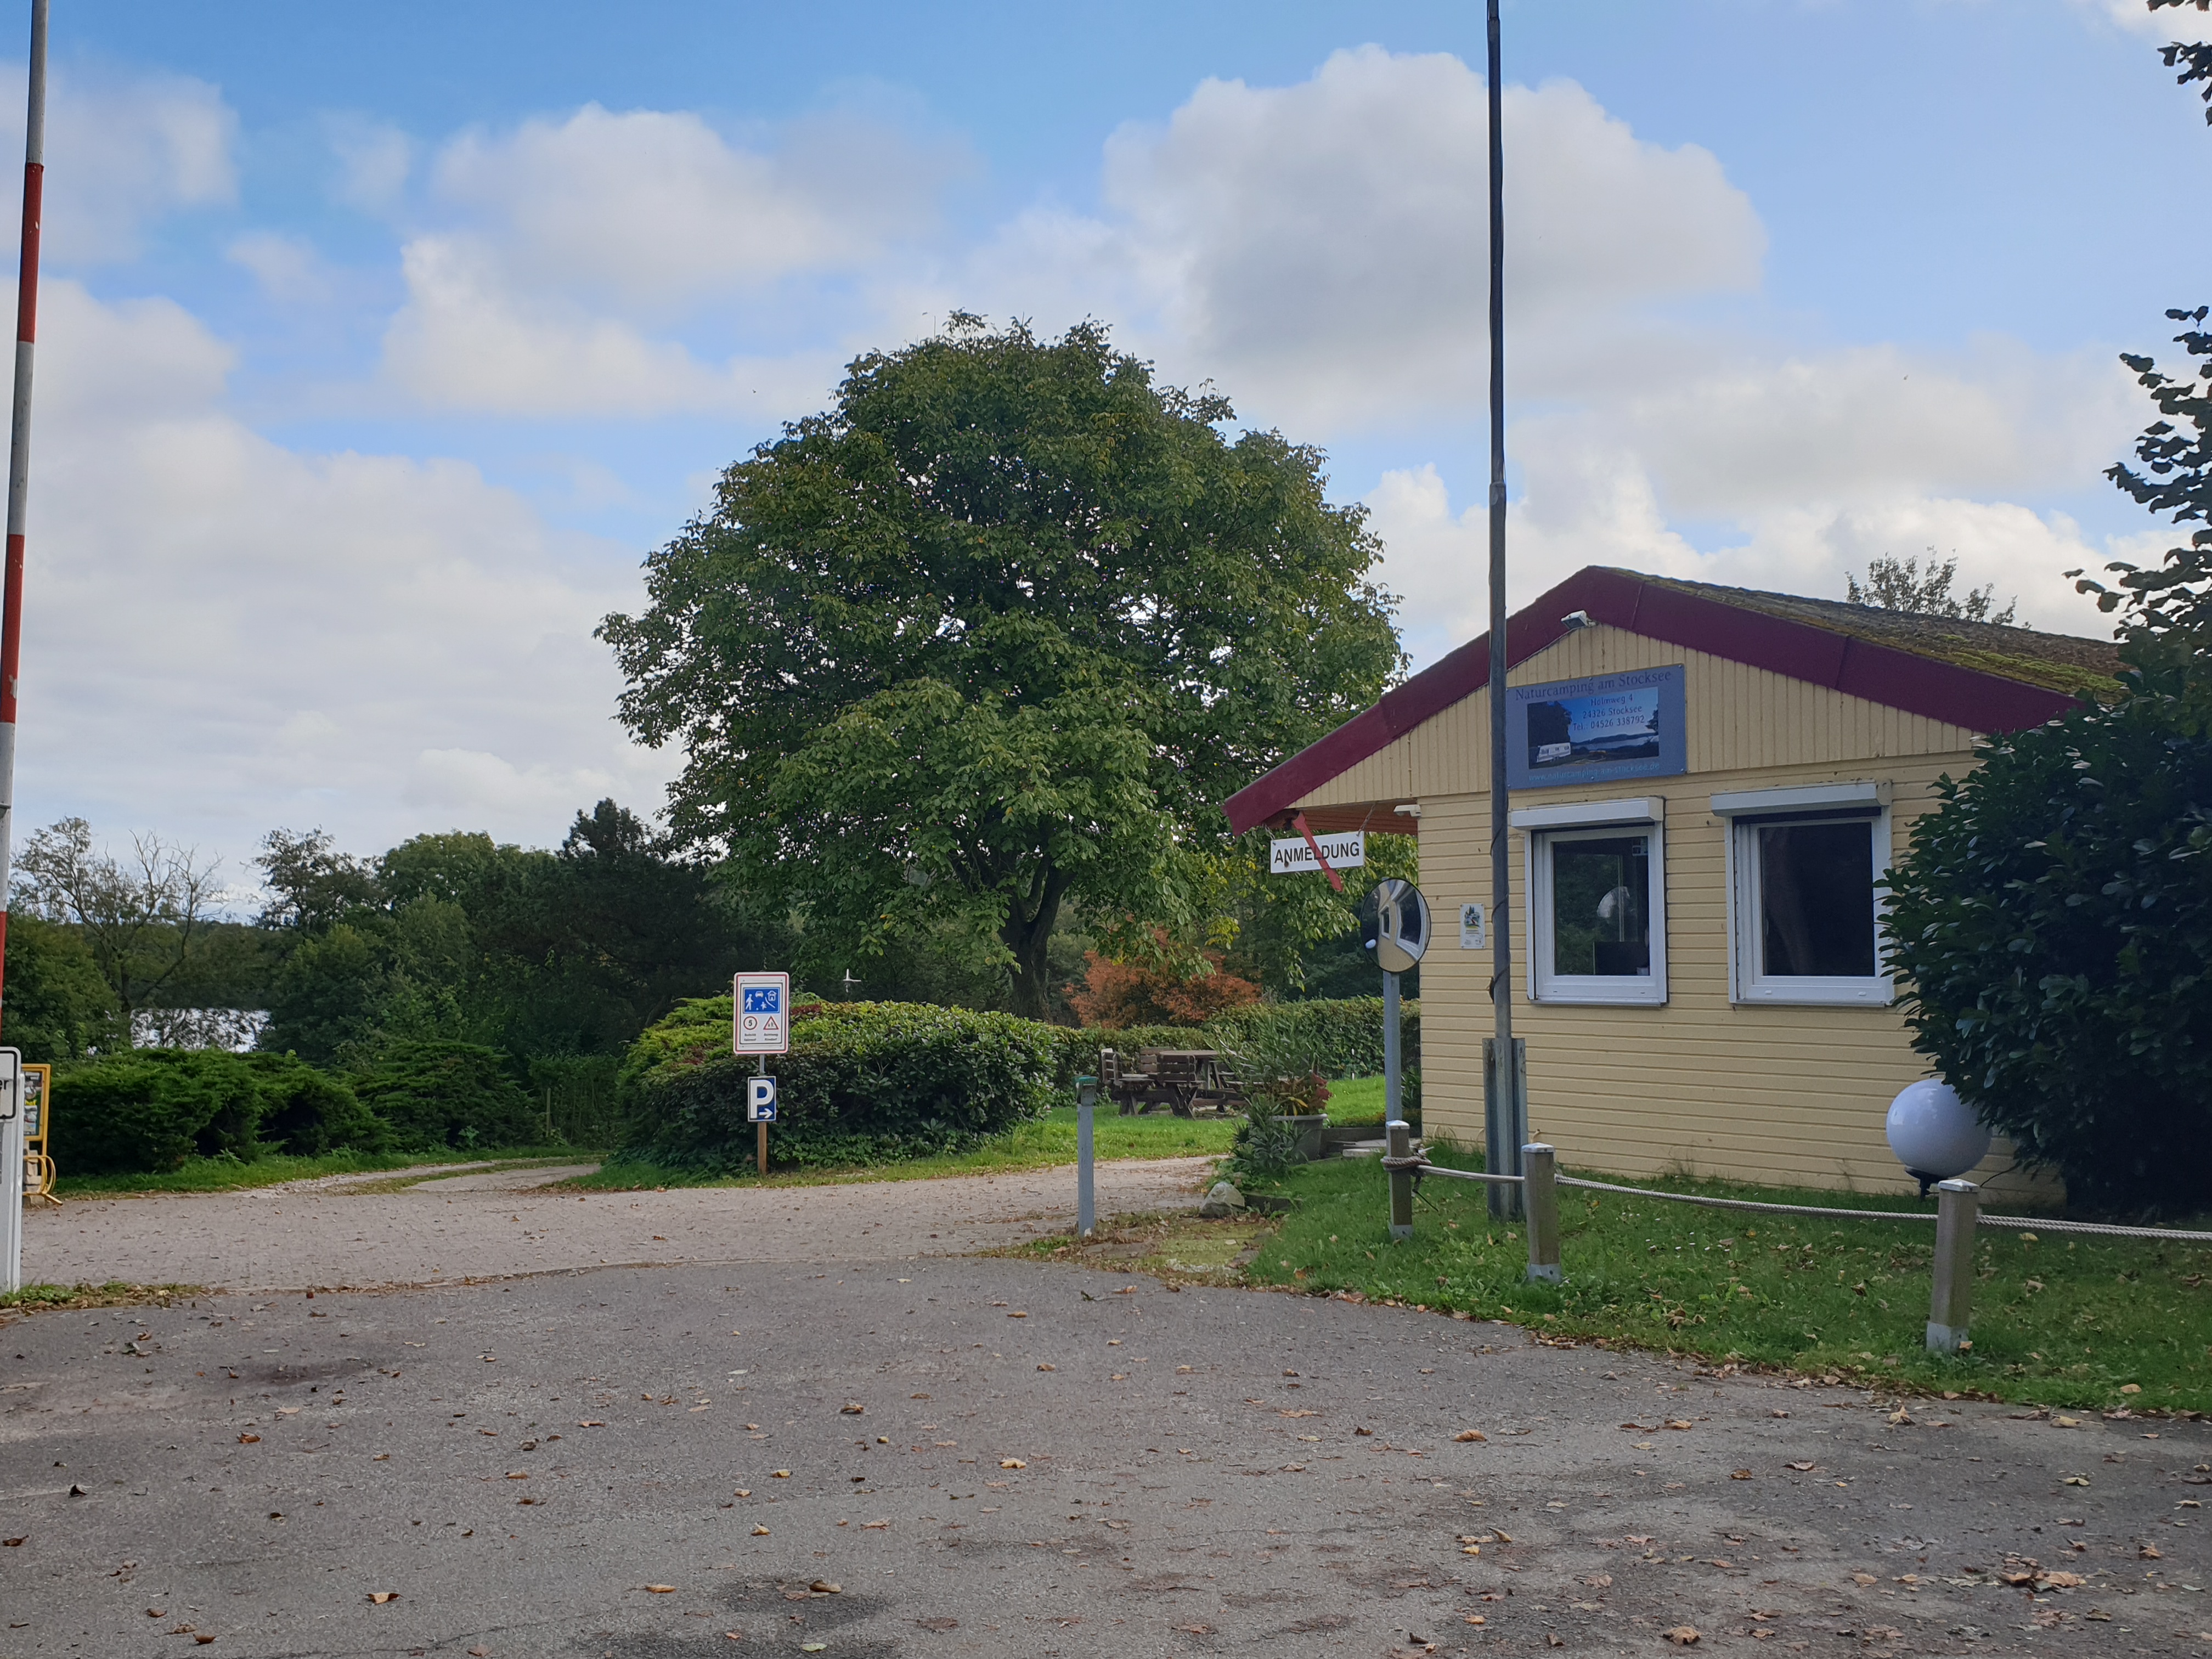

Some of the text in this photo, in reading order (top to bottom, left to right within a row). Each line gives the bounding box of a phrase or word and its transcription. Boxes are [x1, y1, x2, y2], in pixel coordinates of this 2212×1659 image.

[1515, 670, 1672, 701] Naturcamping am Stocksee
[1591, 693, 1634, 707] Holmweg 4
[1583, 705, 1643, 719] 24326 Stocksee
[1590, 718, 1614, 729] 04526
[1617, 715, 1645, 726] 338792
[749, 1079, 774, 1119] P
